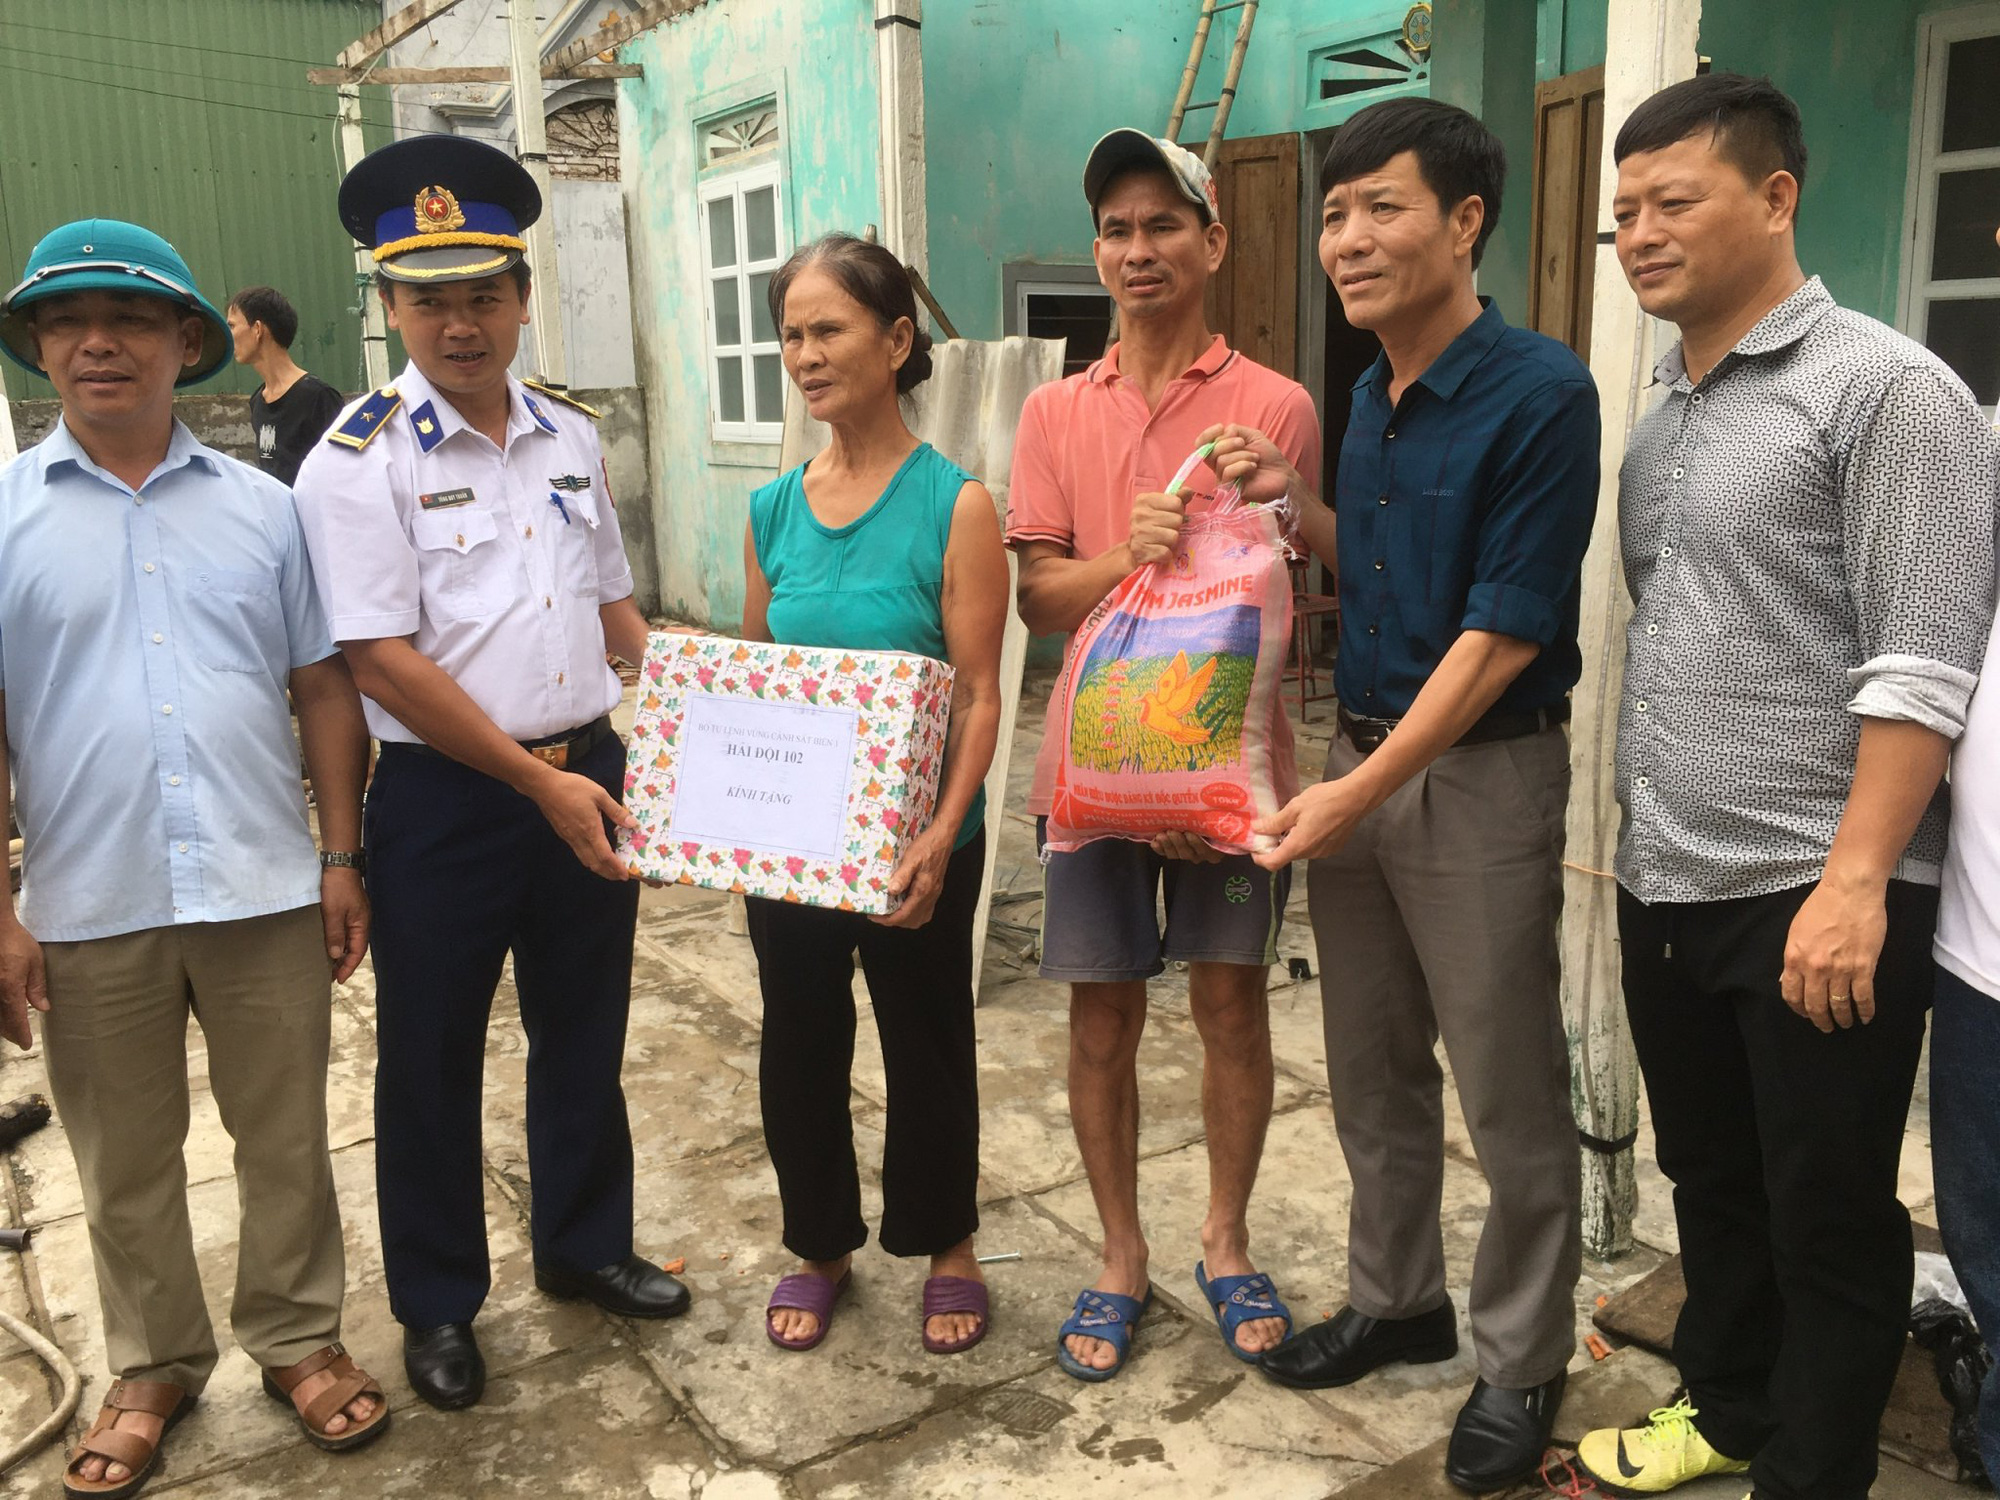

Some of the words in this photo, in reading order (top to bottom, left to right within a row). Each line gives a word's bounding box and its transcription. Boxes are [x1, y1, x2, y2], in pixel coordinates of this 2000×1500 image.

[1167, 574, 1254, 610] JASMINE
[726, 741, 751, 757] HẢI
[755, 746, 780, 763] ĐỘI
[784, 751, 804, 764] 102
[726, 784, 758, 801] KÍNH
[759, 789, 793, 805] TẶNG
